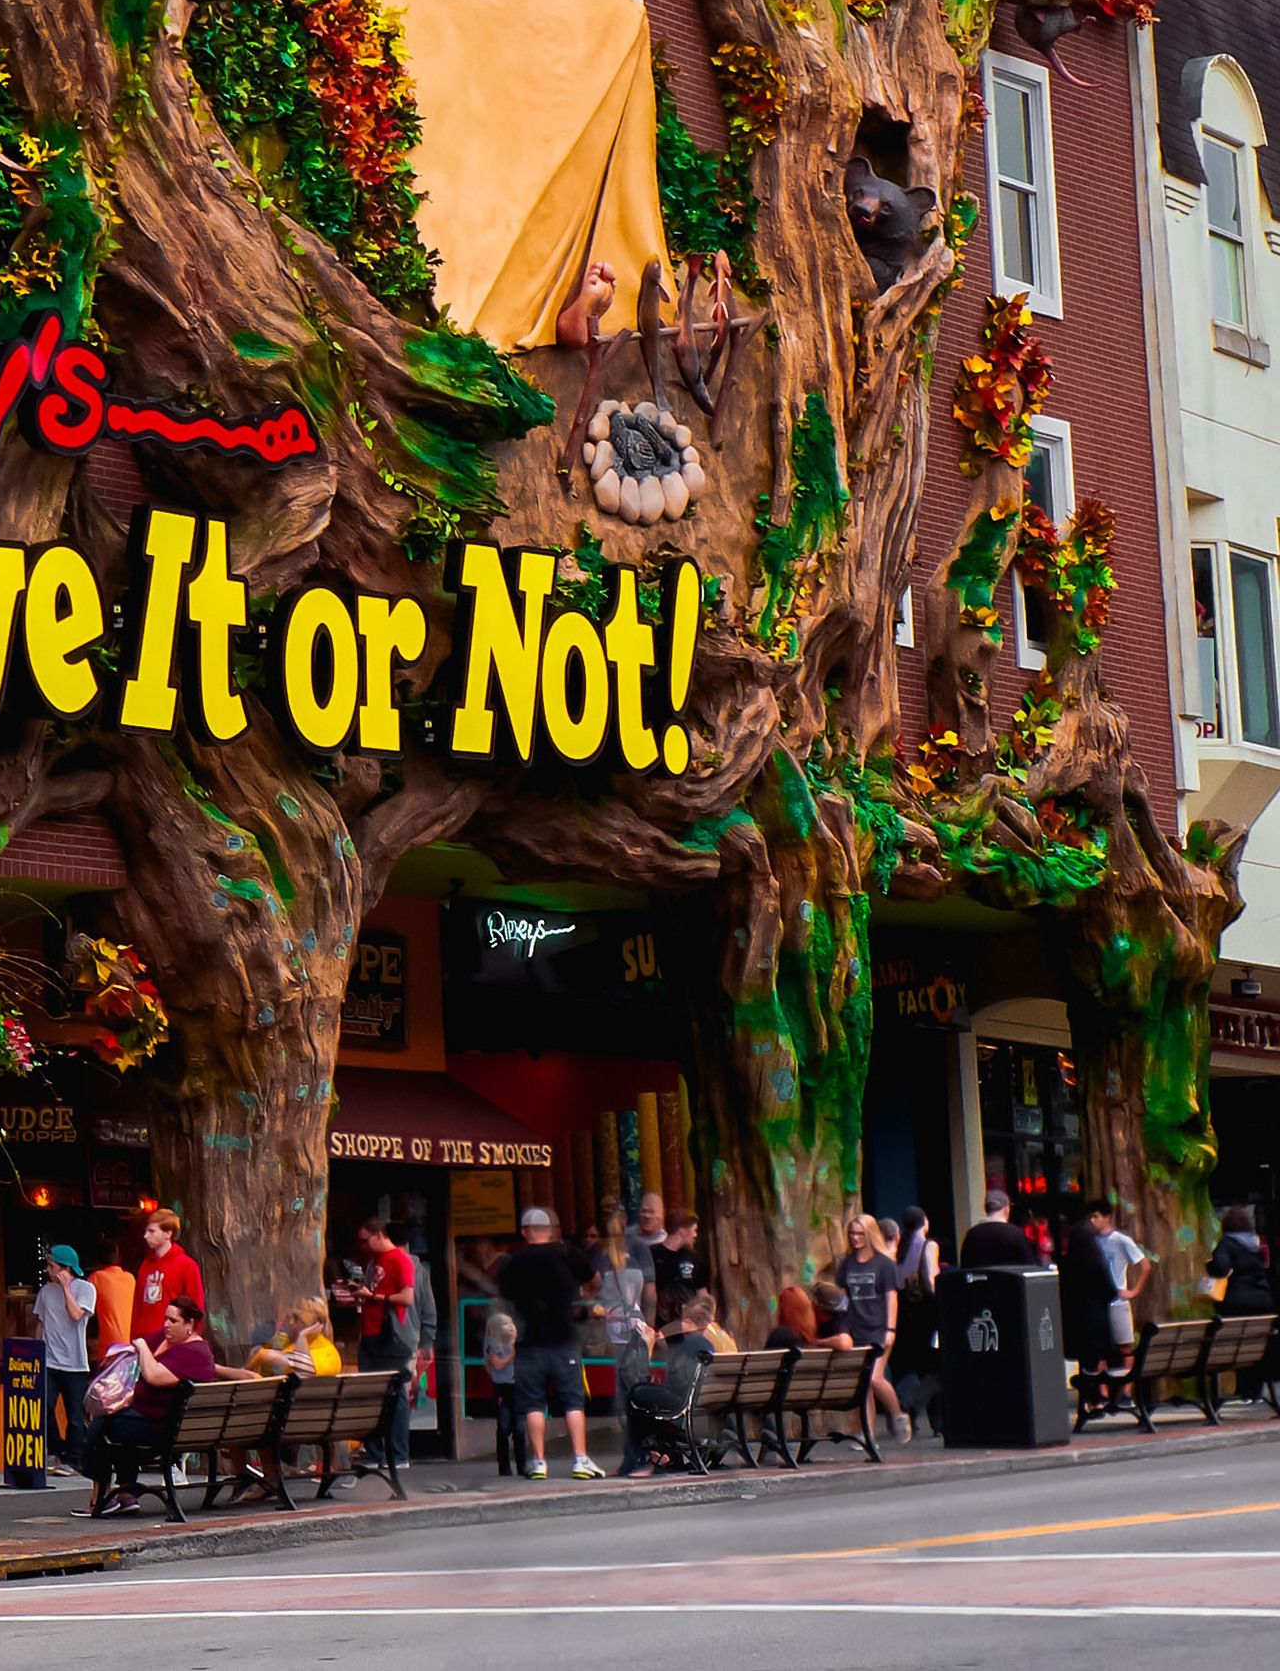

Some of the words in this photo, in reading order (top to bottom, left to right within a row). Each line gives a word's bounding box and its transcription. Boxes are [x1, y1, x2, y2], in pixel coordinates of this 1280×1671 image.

[121, 514, 248, 743] It
[285, 588, 424, 751] or
[452, 546, 699, 776] Not!
[896, 978, 967, 1021] FACTORY
[330, 1131, 404, 1160] SHOPPE
[411, 1138, 433, 1162] OF
[440, 1139, 474, 1164] THE
[479, 1141, 553, 1167] SMOKIES
[8, 1357, 32, 1372] Believe
[9, 1395, 41, 1431] NOW
[6, 1433, 43, 1469] OPEN
